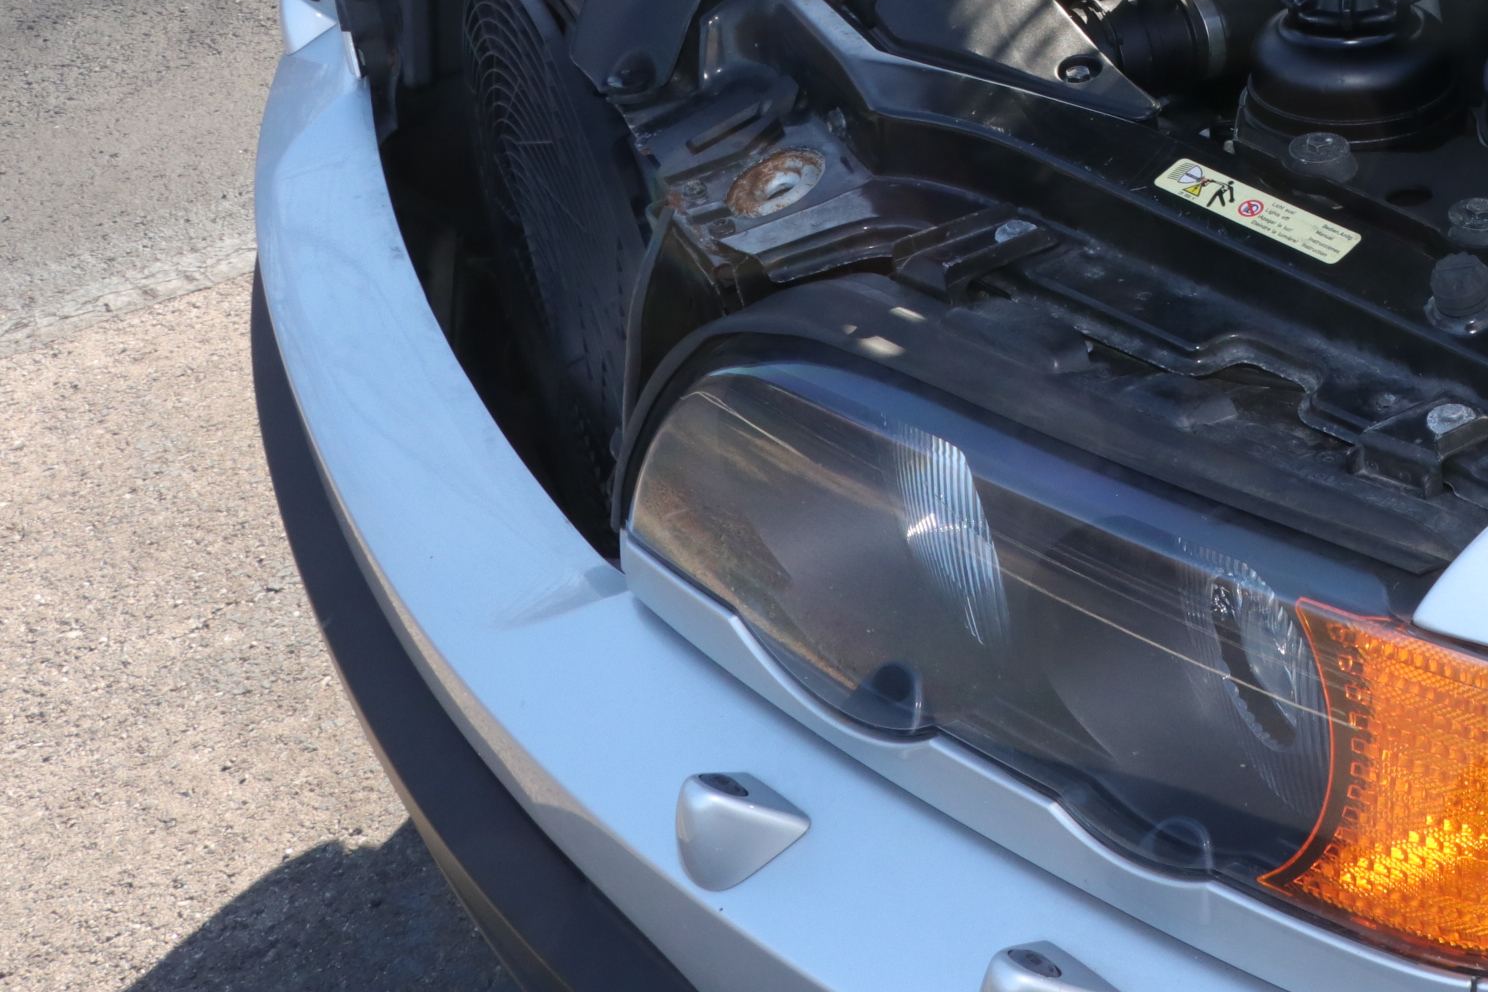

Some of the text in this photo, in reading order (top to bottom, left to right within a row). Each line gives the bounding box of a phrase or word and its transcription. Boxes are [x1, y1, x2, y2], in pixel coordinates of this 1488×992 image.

[1271, 202, 1285, 210] Licht
[1265, 207, 1281, 217] Lights
[1315, 230, 1335, 241] Manual
[1301, 242, 1328, 257] Instruction
[1307, 237, 1341, 254] Instrucciones
